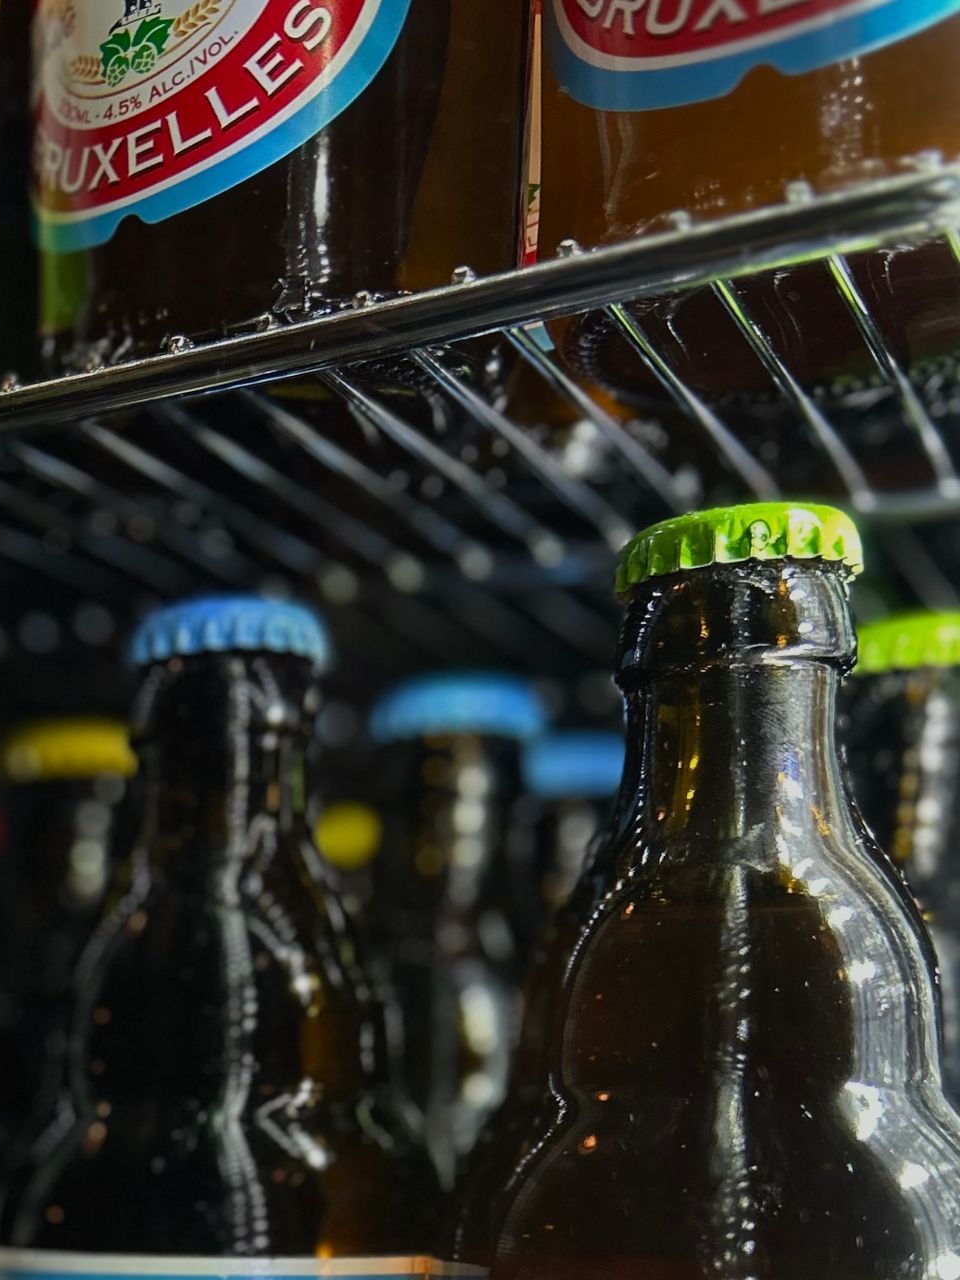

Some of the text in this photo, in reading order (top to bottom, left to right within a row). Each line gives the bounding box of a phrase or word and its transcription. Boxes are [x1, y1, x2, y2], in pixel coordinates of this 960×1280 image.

[37, 0, 333, 194] RUXELLES
[103, 95, 143, 120] 4.5%
[148, 29, 239, 104] ALC./VOL.
